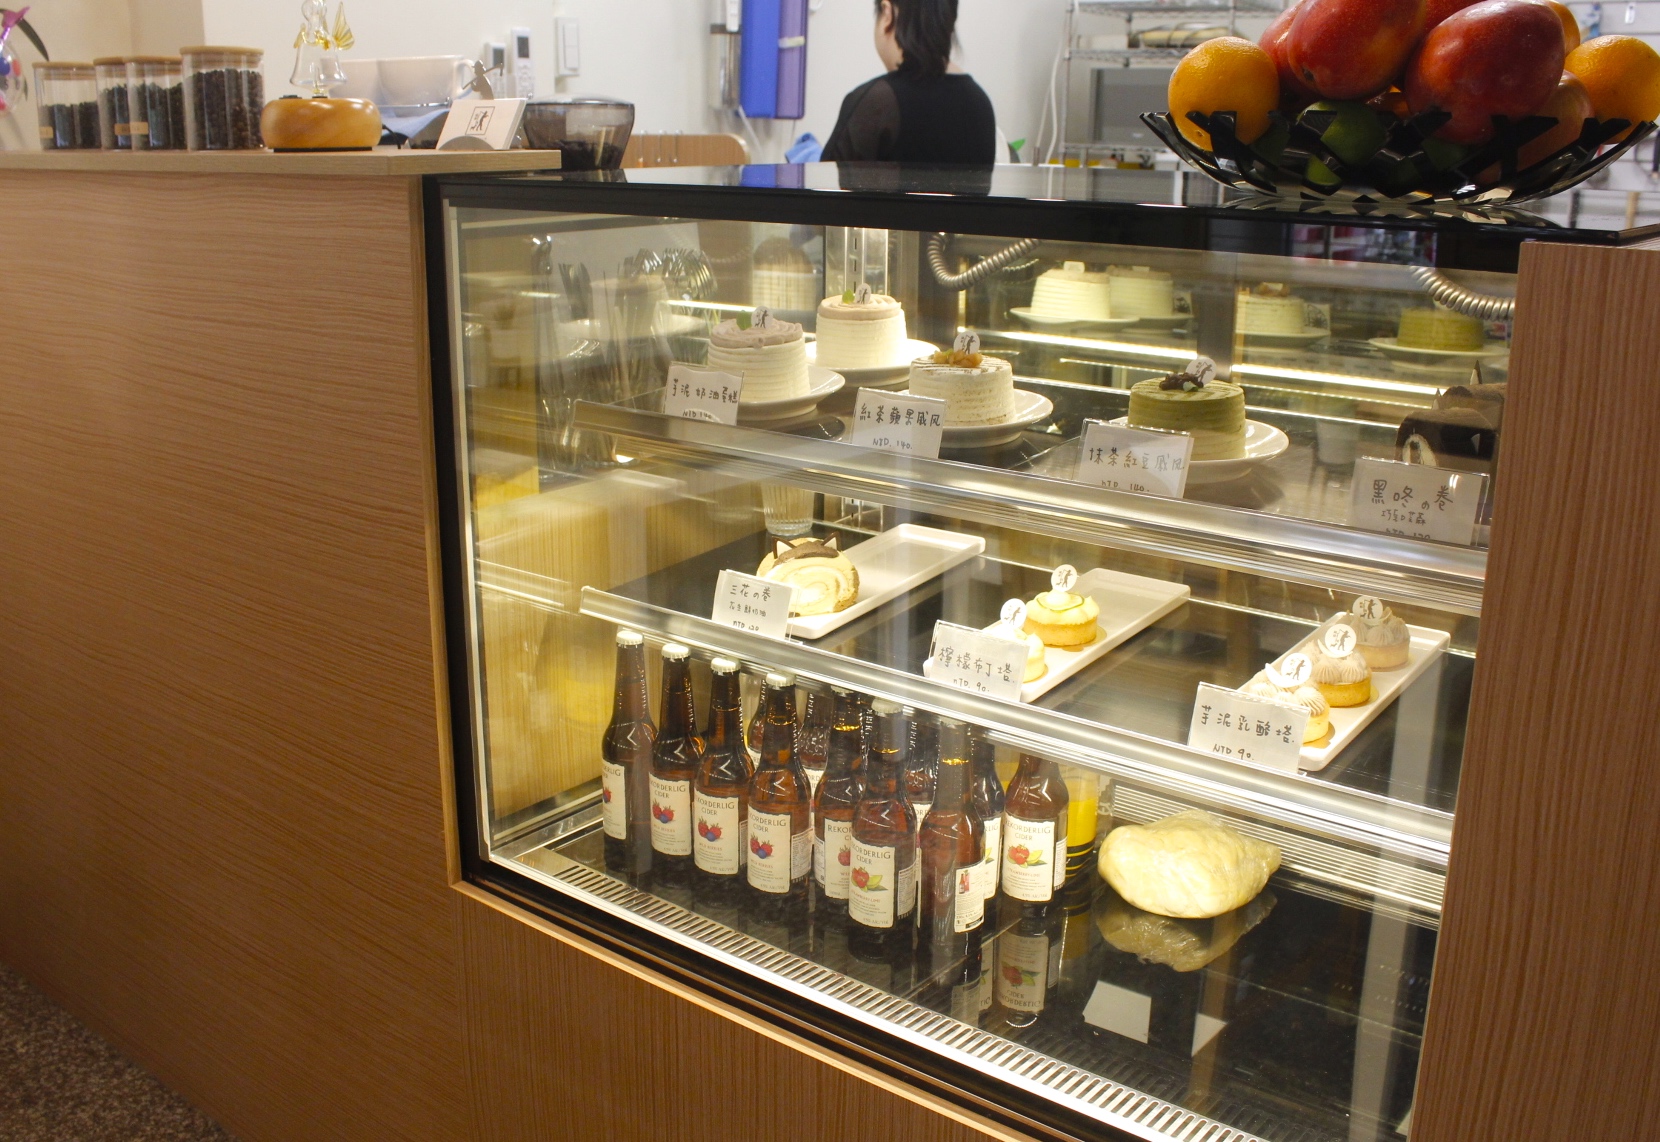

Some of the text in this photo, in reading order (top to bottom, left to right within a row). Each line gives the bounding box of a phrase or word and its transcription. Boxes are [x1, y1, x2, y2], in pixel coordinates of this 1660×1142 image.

[654, 789, 670, 799] CIDER
[701, 806, 718, 816] CIDER
[752, 822, 769, 833] CIDER
[1014, 832, 1033, 841] CIDER
[856, 853, 873, 865] CIDER
